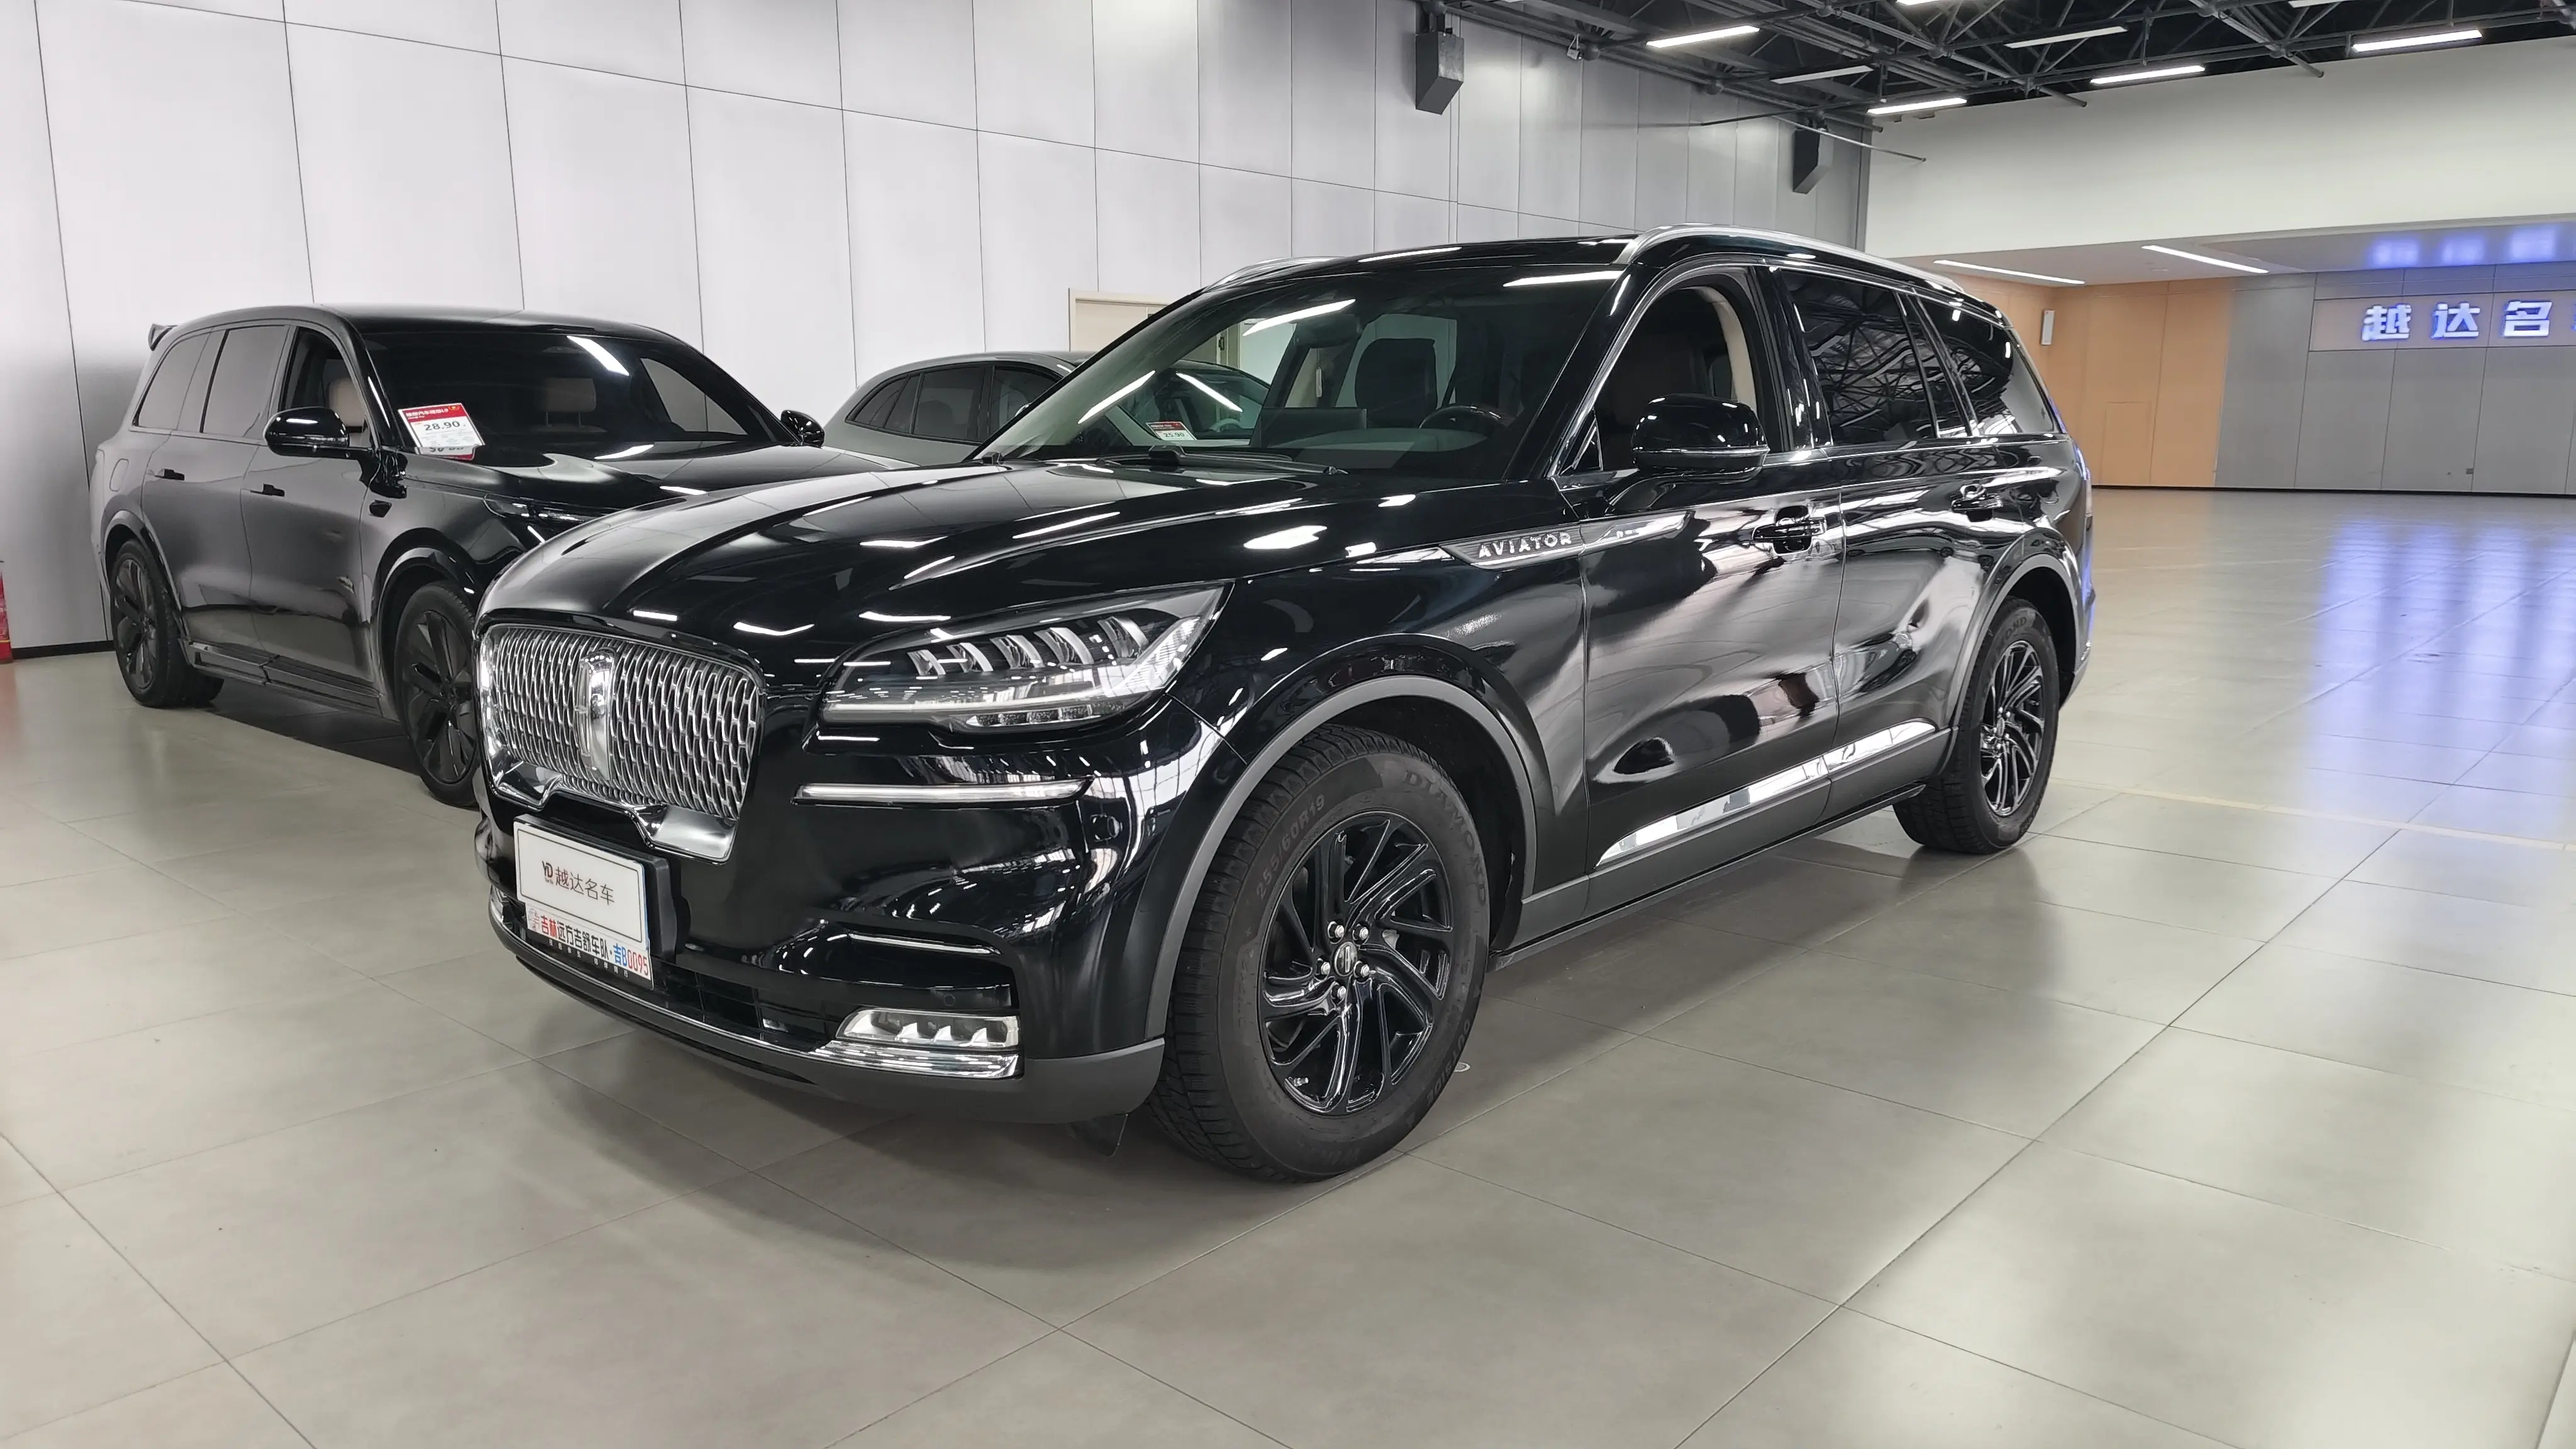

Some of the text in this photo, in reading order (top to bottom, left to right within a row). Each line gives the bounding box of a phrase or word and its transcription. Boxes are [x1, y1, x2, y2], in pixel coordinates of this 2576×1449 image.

[2362, 301, 2576, 341] 越达名
[424, 421, 460, 431] 28.90
[1478, 531, 1572, 558] AVIATOR
[1256, 794, 1325, 900] 255/60R19
[555, 866, 615, 906] 越达名车
